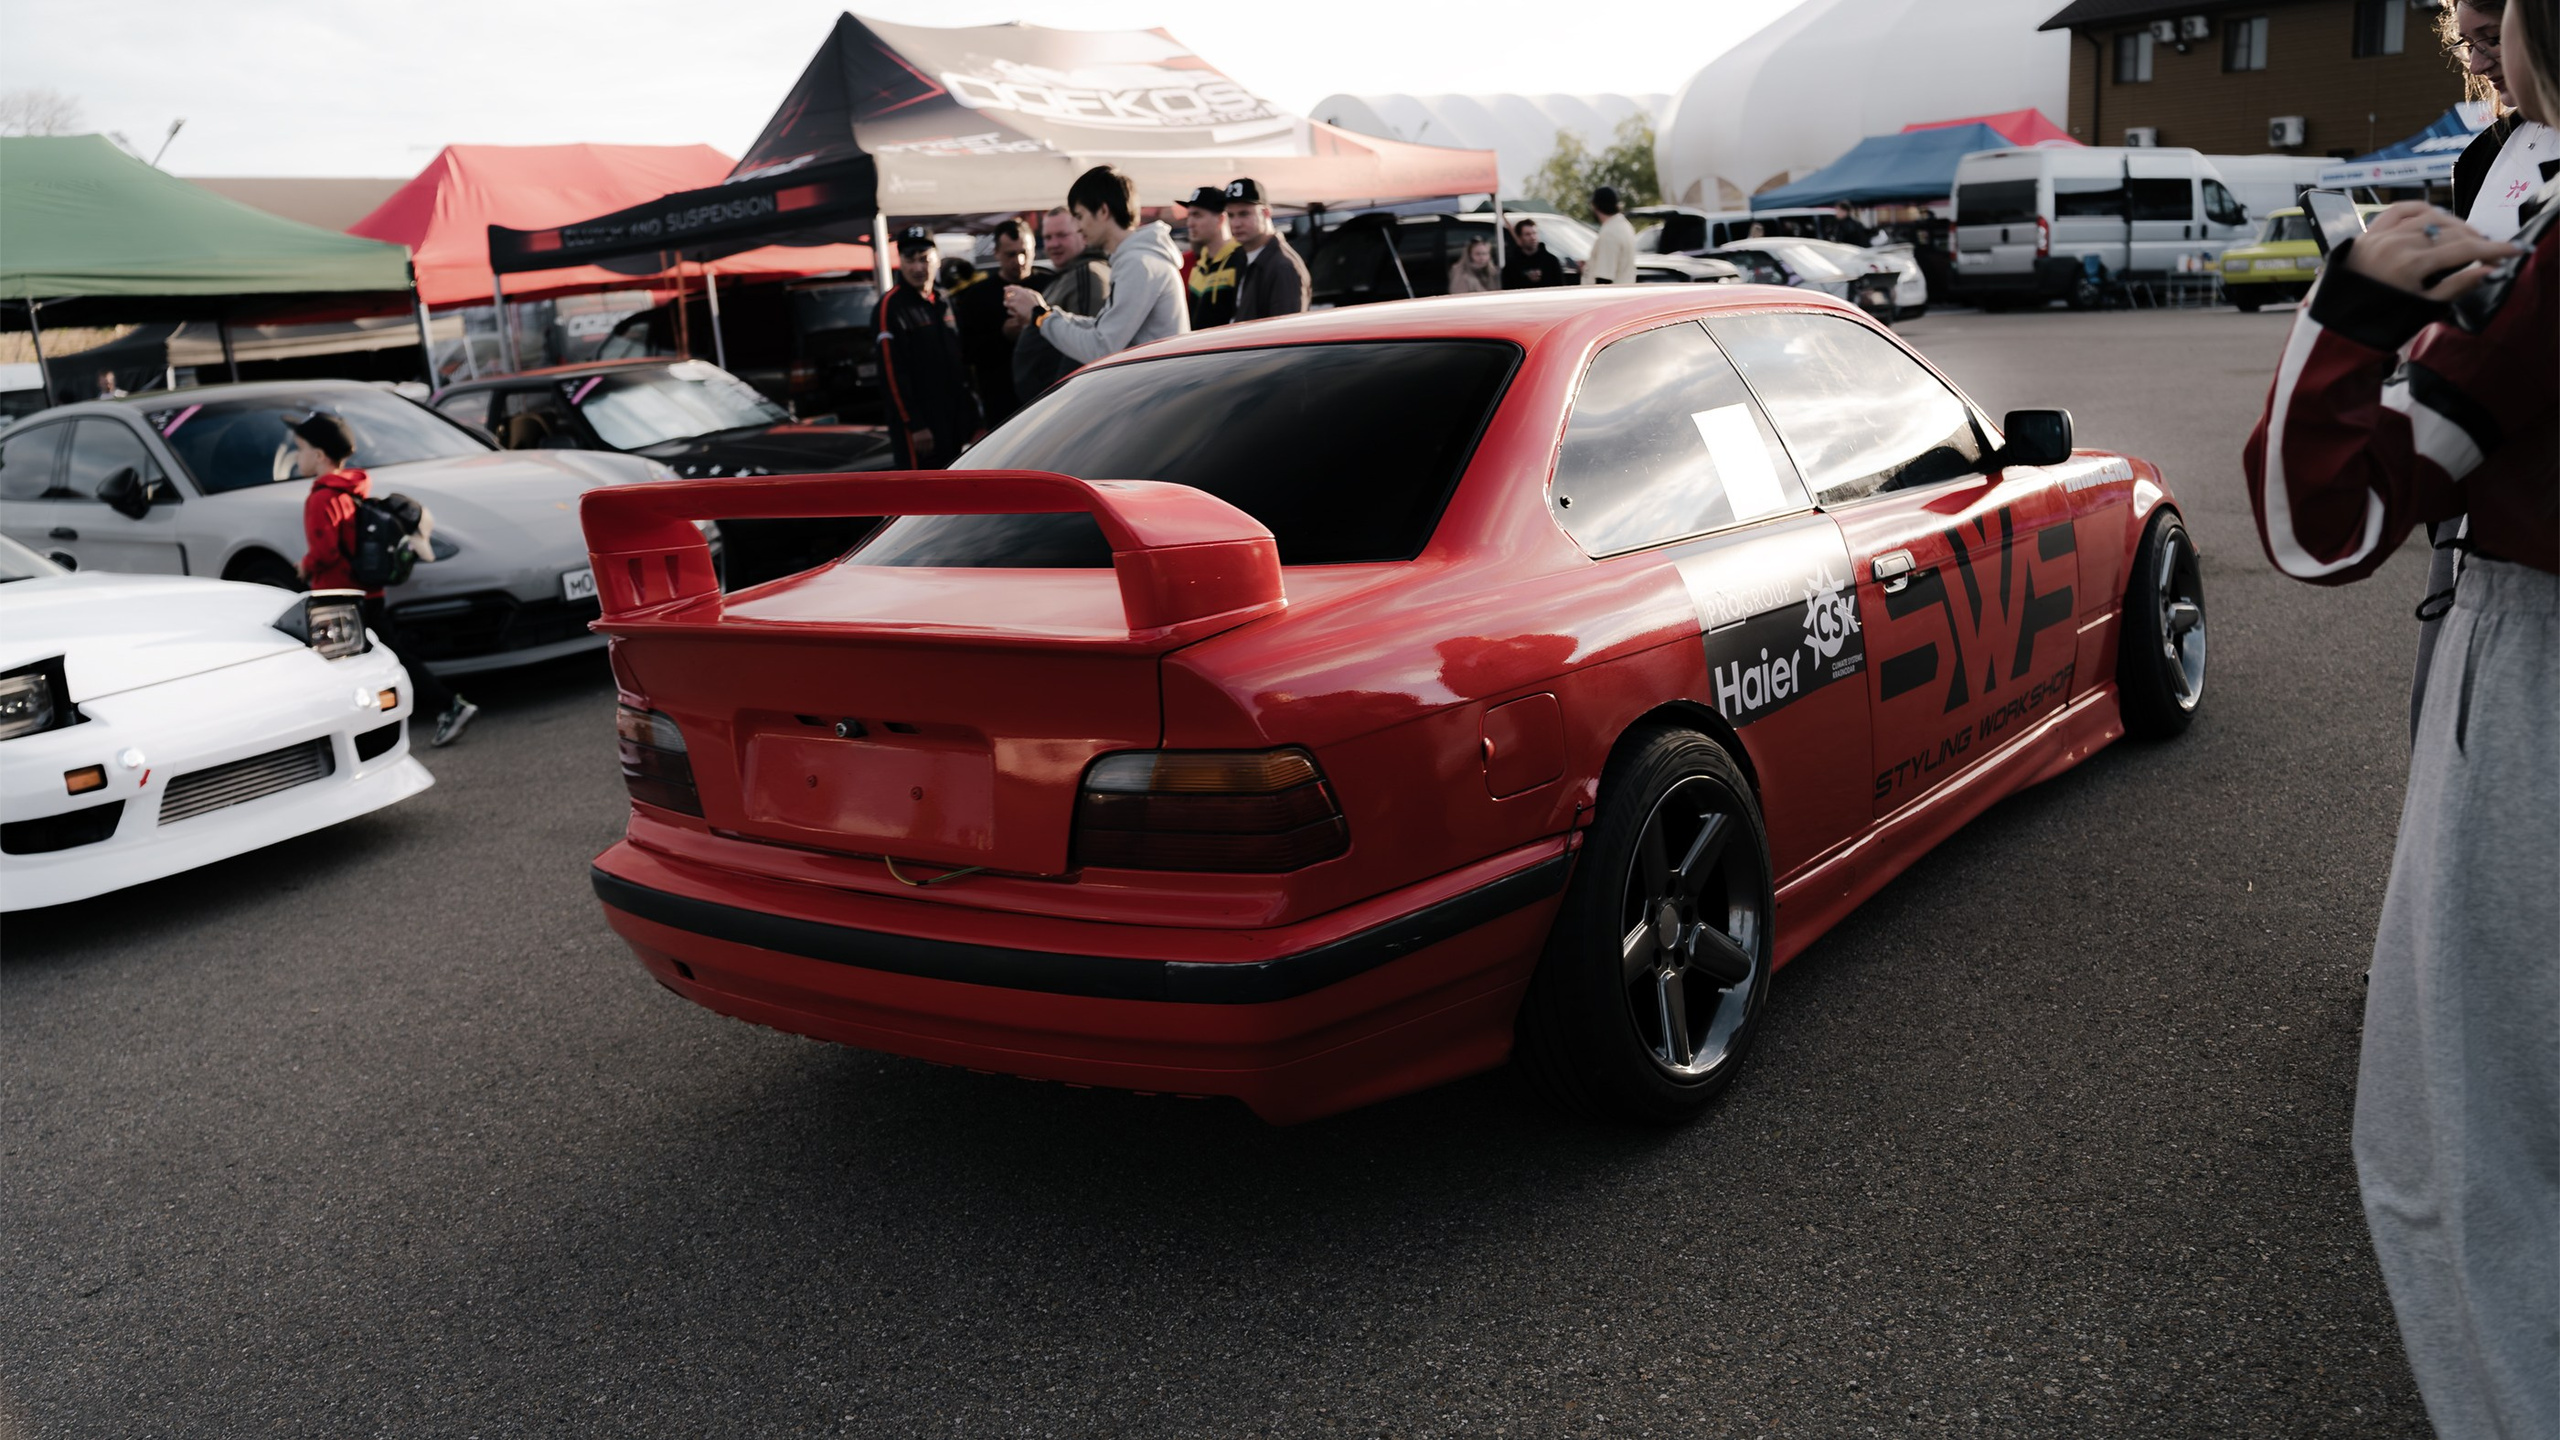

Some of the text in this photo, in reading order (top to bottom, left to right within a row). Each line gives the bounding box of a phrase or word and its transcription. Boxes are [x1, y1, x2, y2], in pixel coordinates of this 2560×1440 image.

[665, 195, 773, 233] SUSPENSION
[1714, 647, 1801, 720] Haier
[1874, 661, 2075, 800] STYLING WORKSHOP
